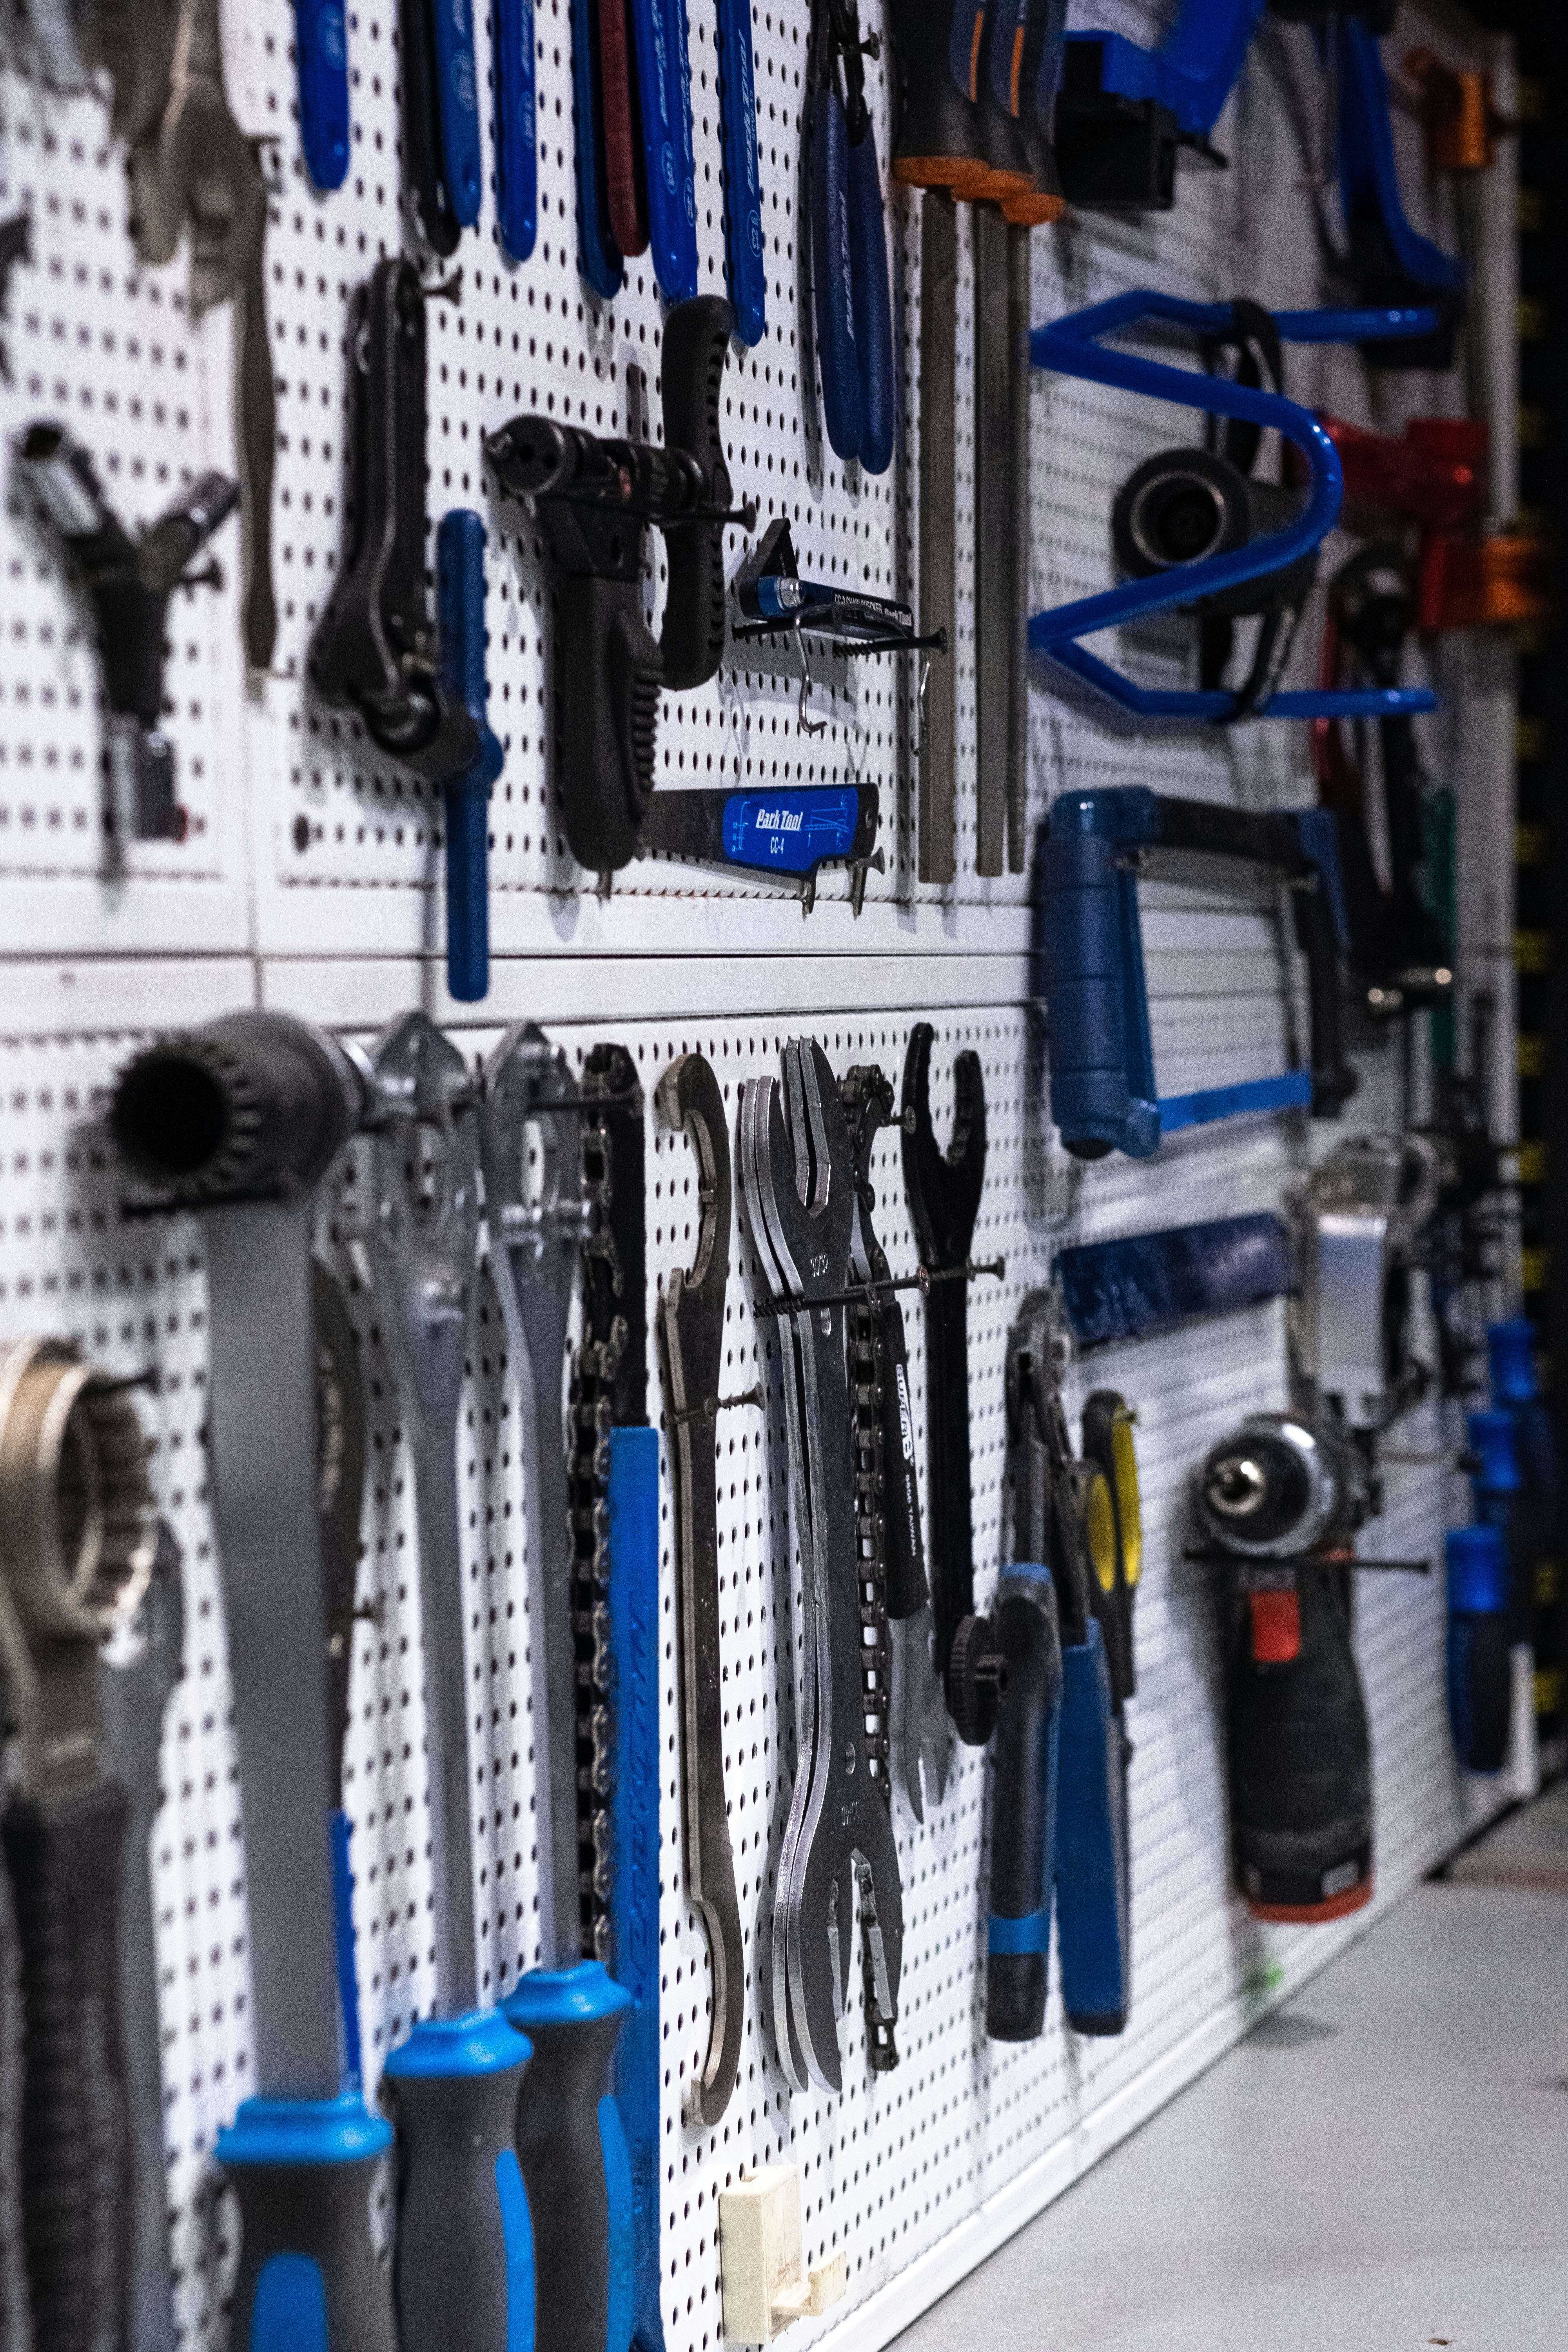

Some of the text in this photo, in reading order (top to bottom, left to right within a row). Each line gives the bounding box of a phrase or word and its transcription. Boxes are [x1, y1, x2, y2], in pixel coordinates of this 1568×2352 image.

[738, 27, 755, 196] Park Tool
[898, 610, 912, 627] Tool
[755, 808, 804, 832] Park Tool
[769, 836, 784, 855] CC-4
[908, 1506, 917, 1557] TAIWAN
